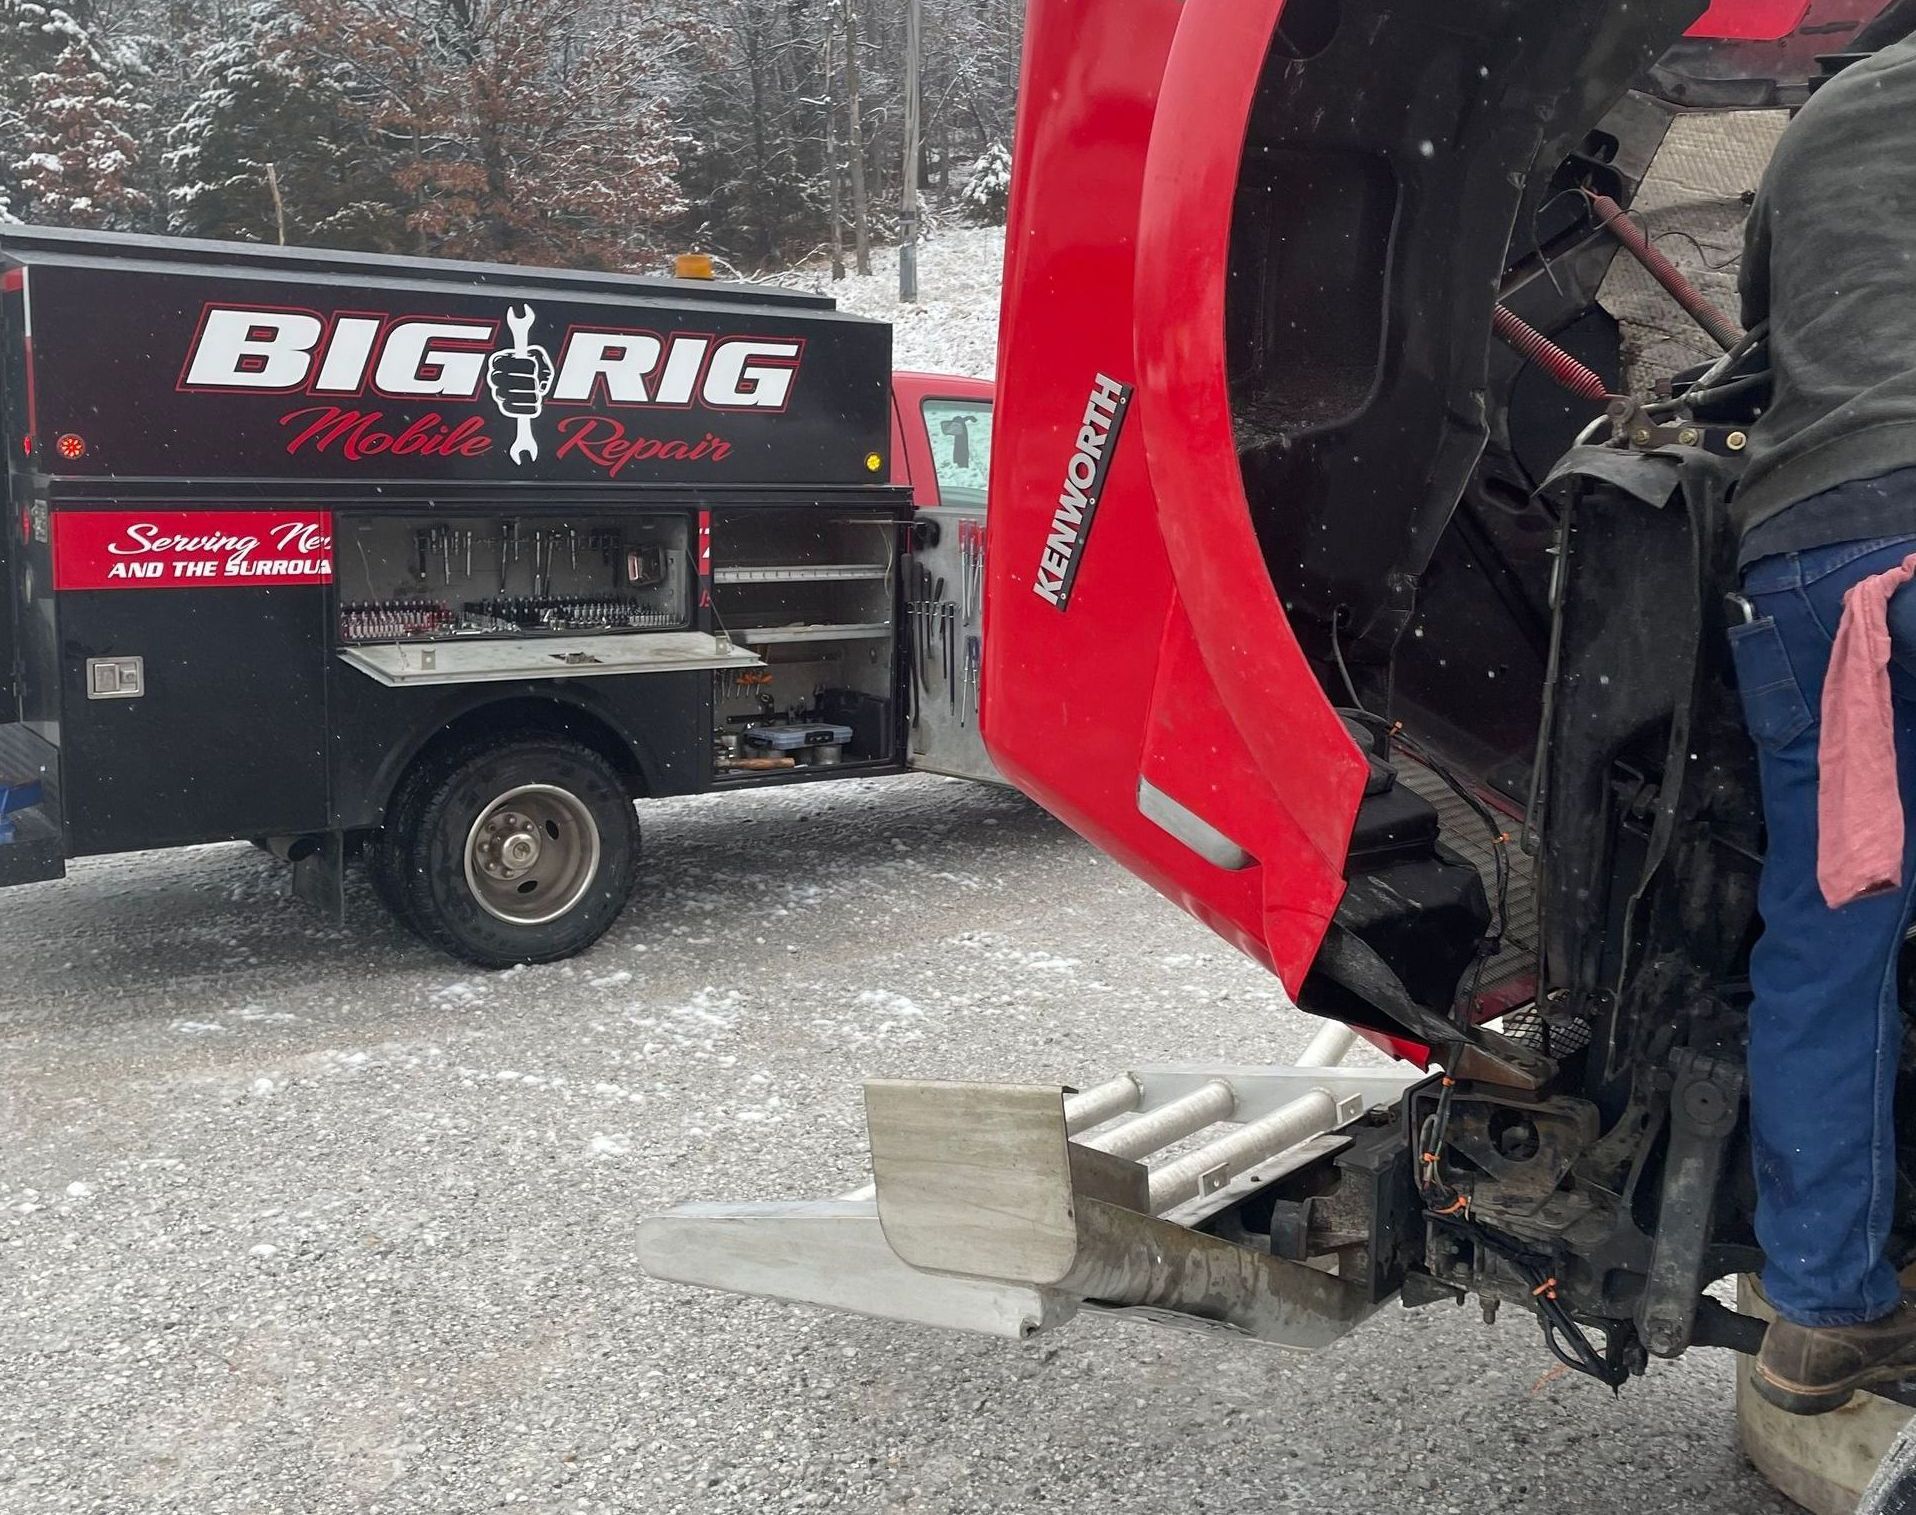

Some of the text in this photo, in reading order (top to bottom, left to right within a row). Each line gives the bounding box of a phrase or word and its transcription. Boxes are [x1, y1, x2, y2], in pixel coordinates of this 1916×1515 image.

[180, 305, 803, 410] BIG RIG
[278, 406, 735, 478] Mobile Repair
[1032, 372, 1123, 606] KENWORTH
[107, 523, 260, 564] Serving
[107, 562, 164, 578] AND
[172, 561, 217, 577] THE
